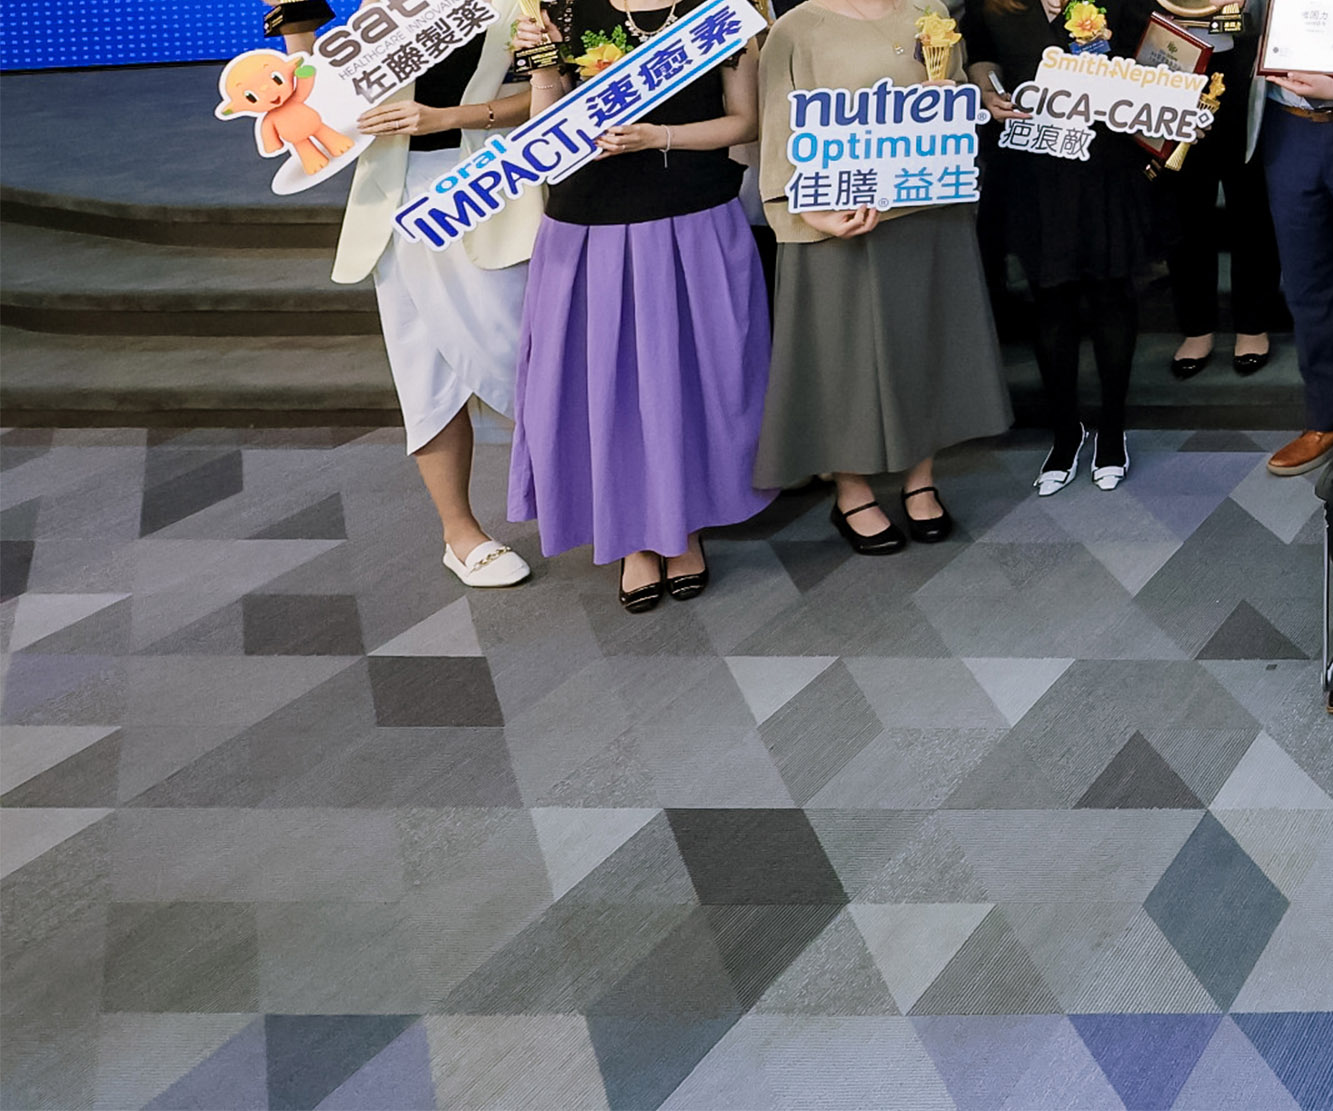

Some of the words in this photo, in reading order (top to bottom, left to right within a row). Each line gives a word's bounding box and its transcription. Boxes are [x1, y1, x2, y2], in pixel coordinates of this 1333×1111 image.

[338, 29, 407, 81] HEALTHCARE
[586, 5, 743, 128] 速癒素
[792, 80, 977, 128] nutren
[1014, 84, 1198, 140] CICA-CARE
[434, 138, 508, 194] oral
[791, 130, 975, 169] Optimum
[413, 118, 581, 248] IMPACT
[789, 168, 879, 209] 佳膳
[892, 164, 977, 203] 益生
